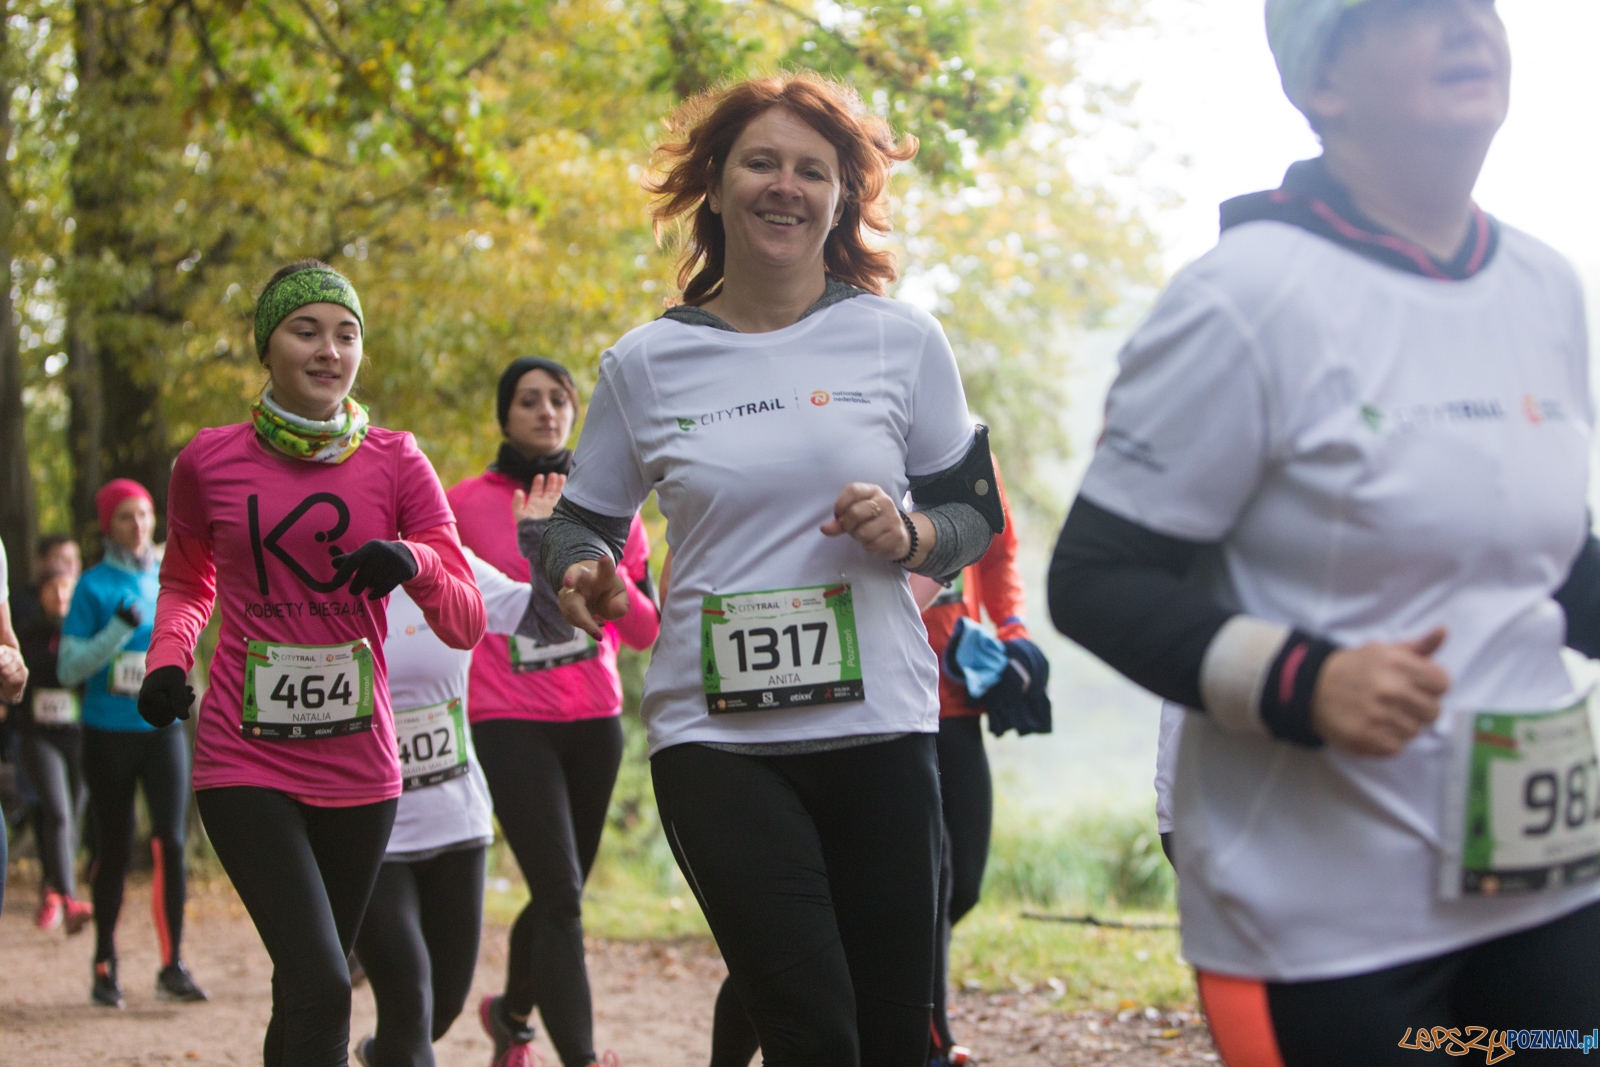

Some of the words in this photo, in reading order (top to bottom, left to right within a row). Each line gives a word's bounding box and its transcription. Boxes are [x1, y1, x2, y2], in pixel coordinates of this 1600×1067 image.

[244, 602, 303, 619] KOBIETY
[309, 602, 366, 618] BIEGAJĄ
[729, 622, 828, 672] 1317
[270, 672, 352, 710] 464
[768, 673, 802, 686] ANITA
[292, 712, 331, 722] NATALIA
[1522, 754, 1600, 838] 98
